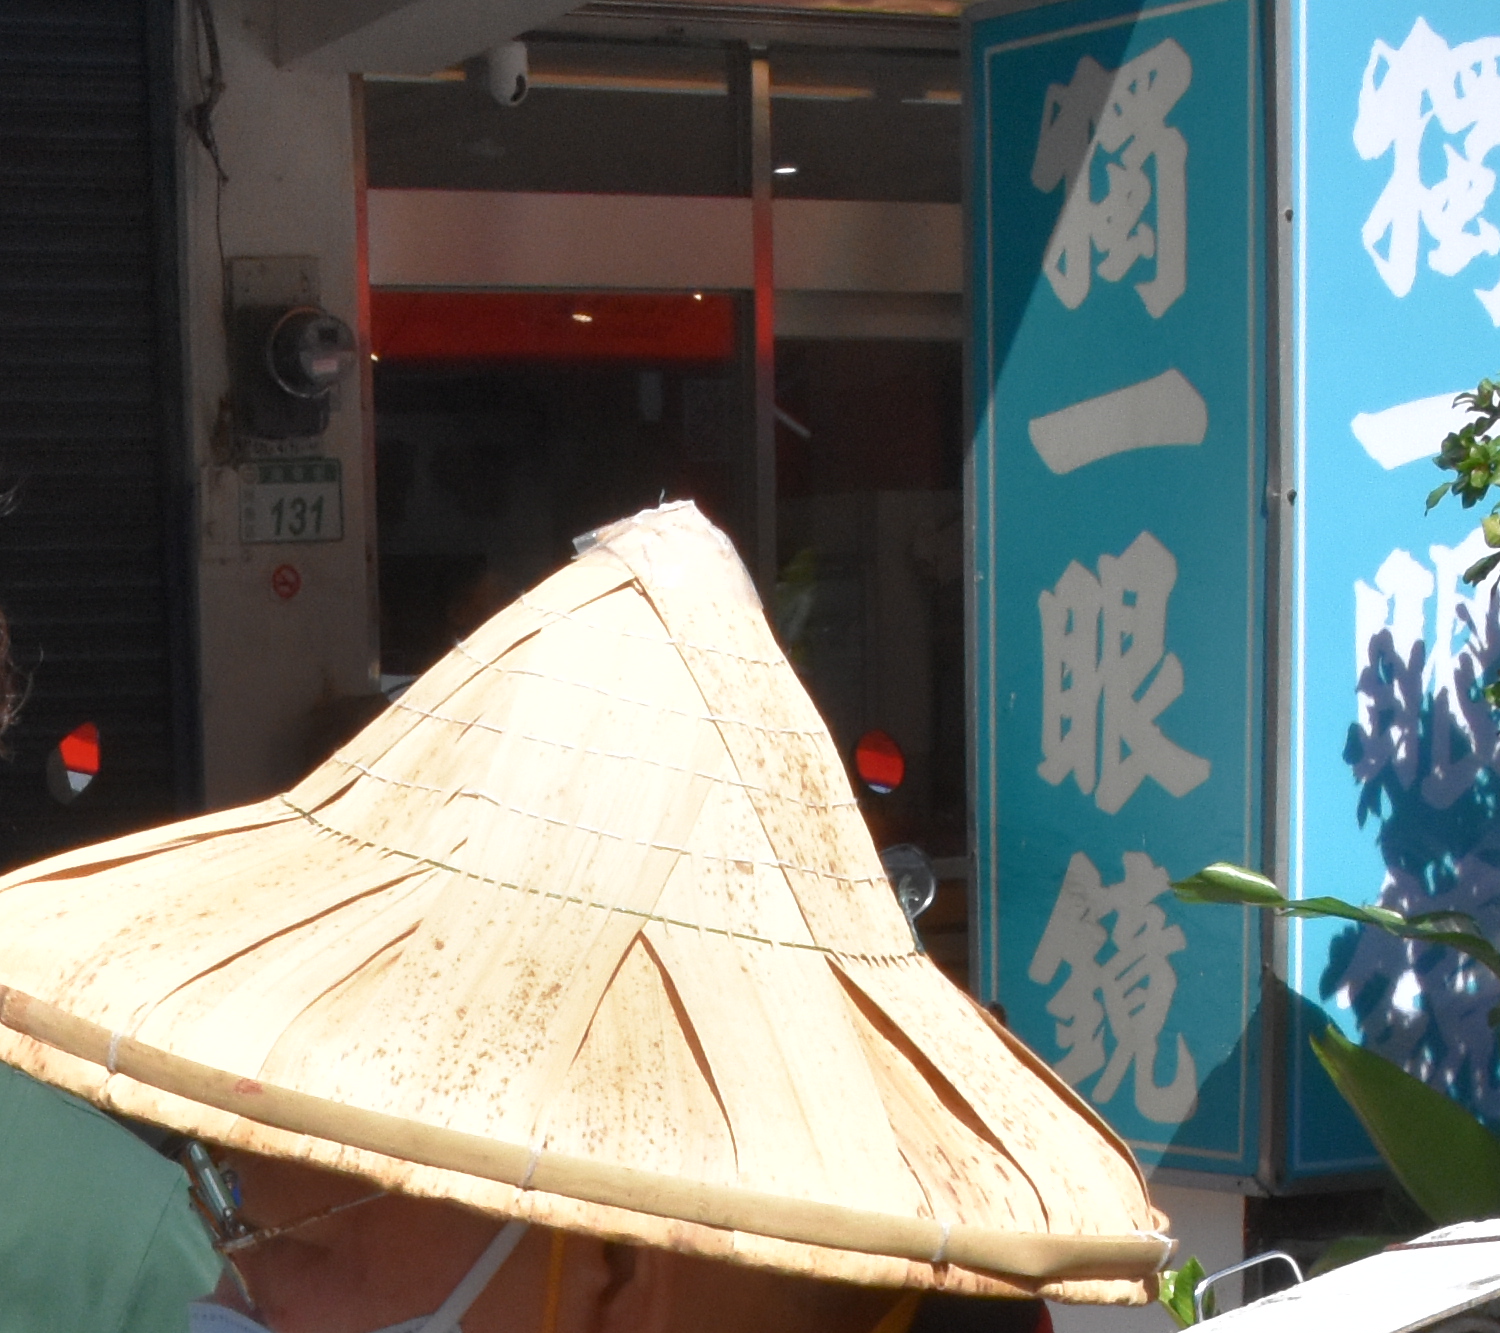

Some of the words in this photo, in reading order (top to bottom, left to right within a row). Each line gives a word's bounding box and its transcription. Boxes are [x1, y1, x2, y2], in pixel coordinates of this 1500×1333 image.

[270, 495, 325, 537] 131
[1029, 36, 1210, 1124] 獨一眼鏡
